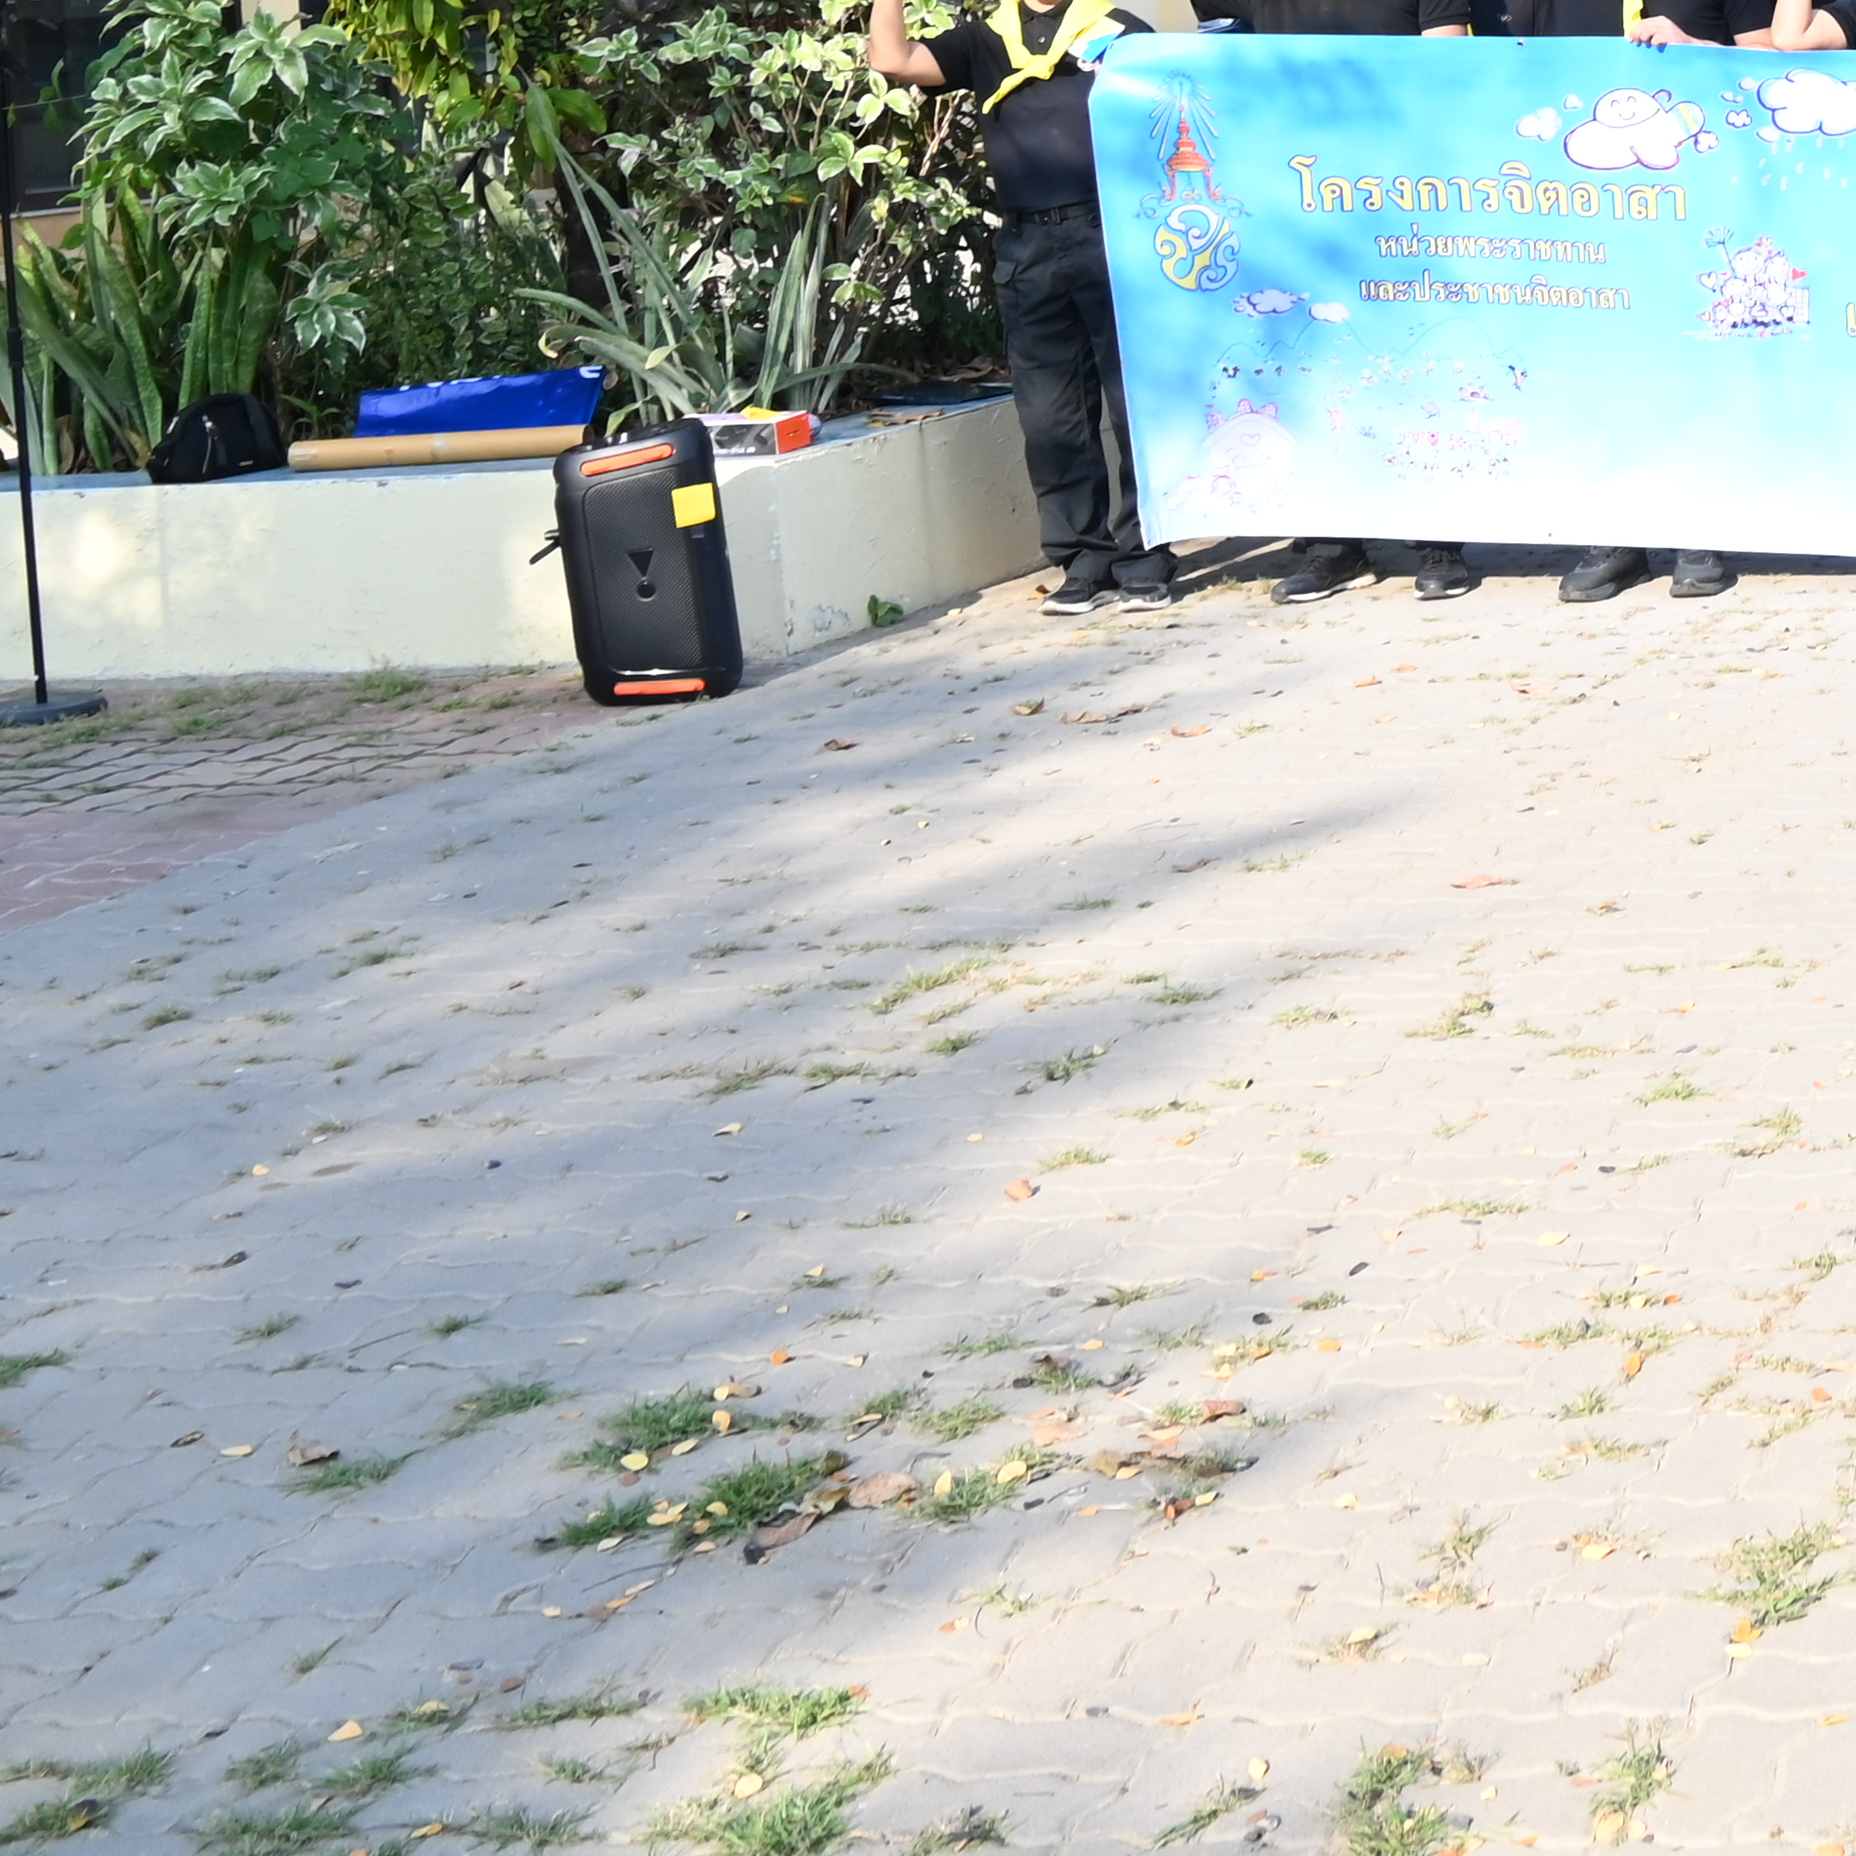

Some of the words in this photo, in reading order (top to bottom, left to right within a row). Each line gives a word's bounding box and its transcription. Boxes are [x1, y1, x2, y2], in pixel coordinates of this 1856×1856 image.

[1288, 154, 1688, 221] โครงการจิตอาสา
[1374, 223, 1607, 264] หน่วยพระราชทาน
[1358, 269, 1631, 309] และประชาชนจิตอาสา
